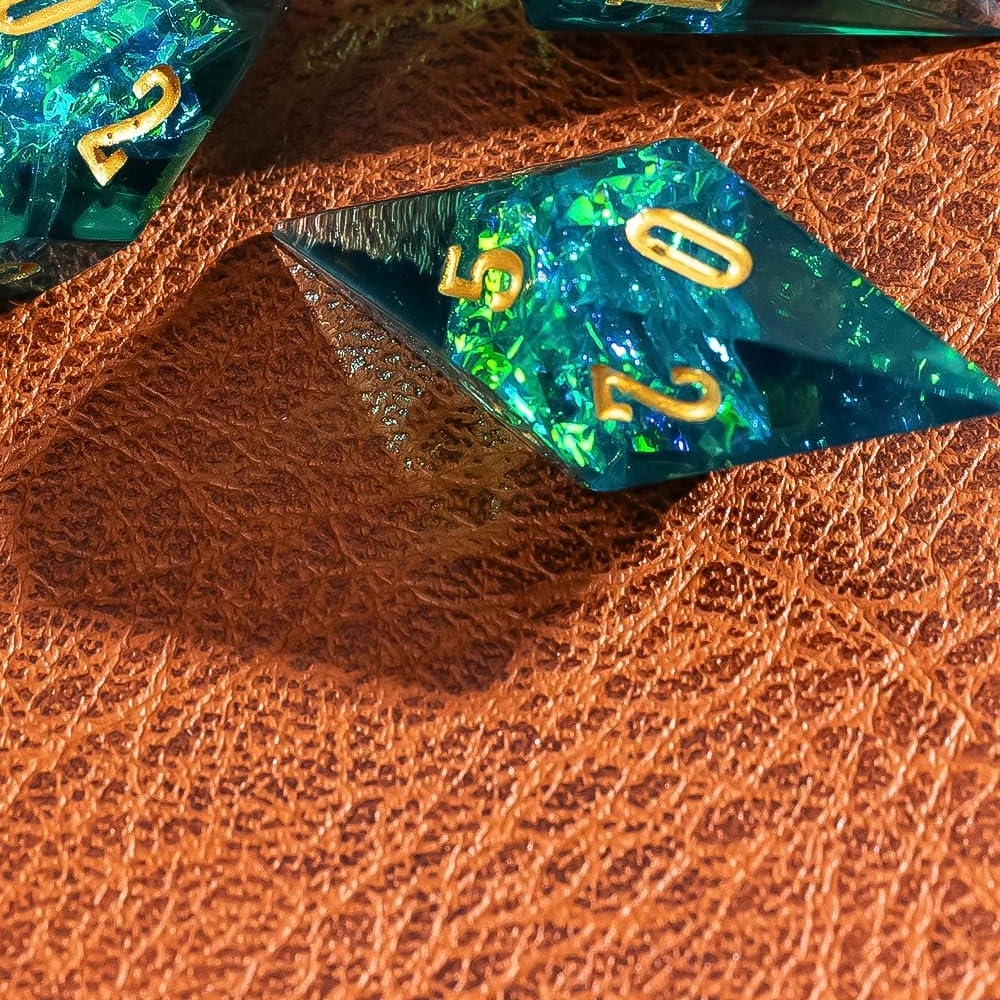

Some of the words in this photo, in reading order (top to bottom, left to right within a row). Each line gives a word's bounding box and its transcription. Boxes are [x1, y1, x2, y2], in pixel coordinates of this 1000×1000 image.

[76, 64, 182, 187] 2
[437, 245, 525, 313] 5
[625, 207, 754, 290] 0
[591, 365, 723, 422] 2
